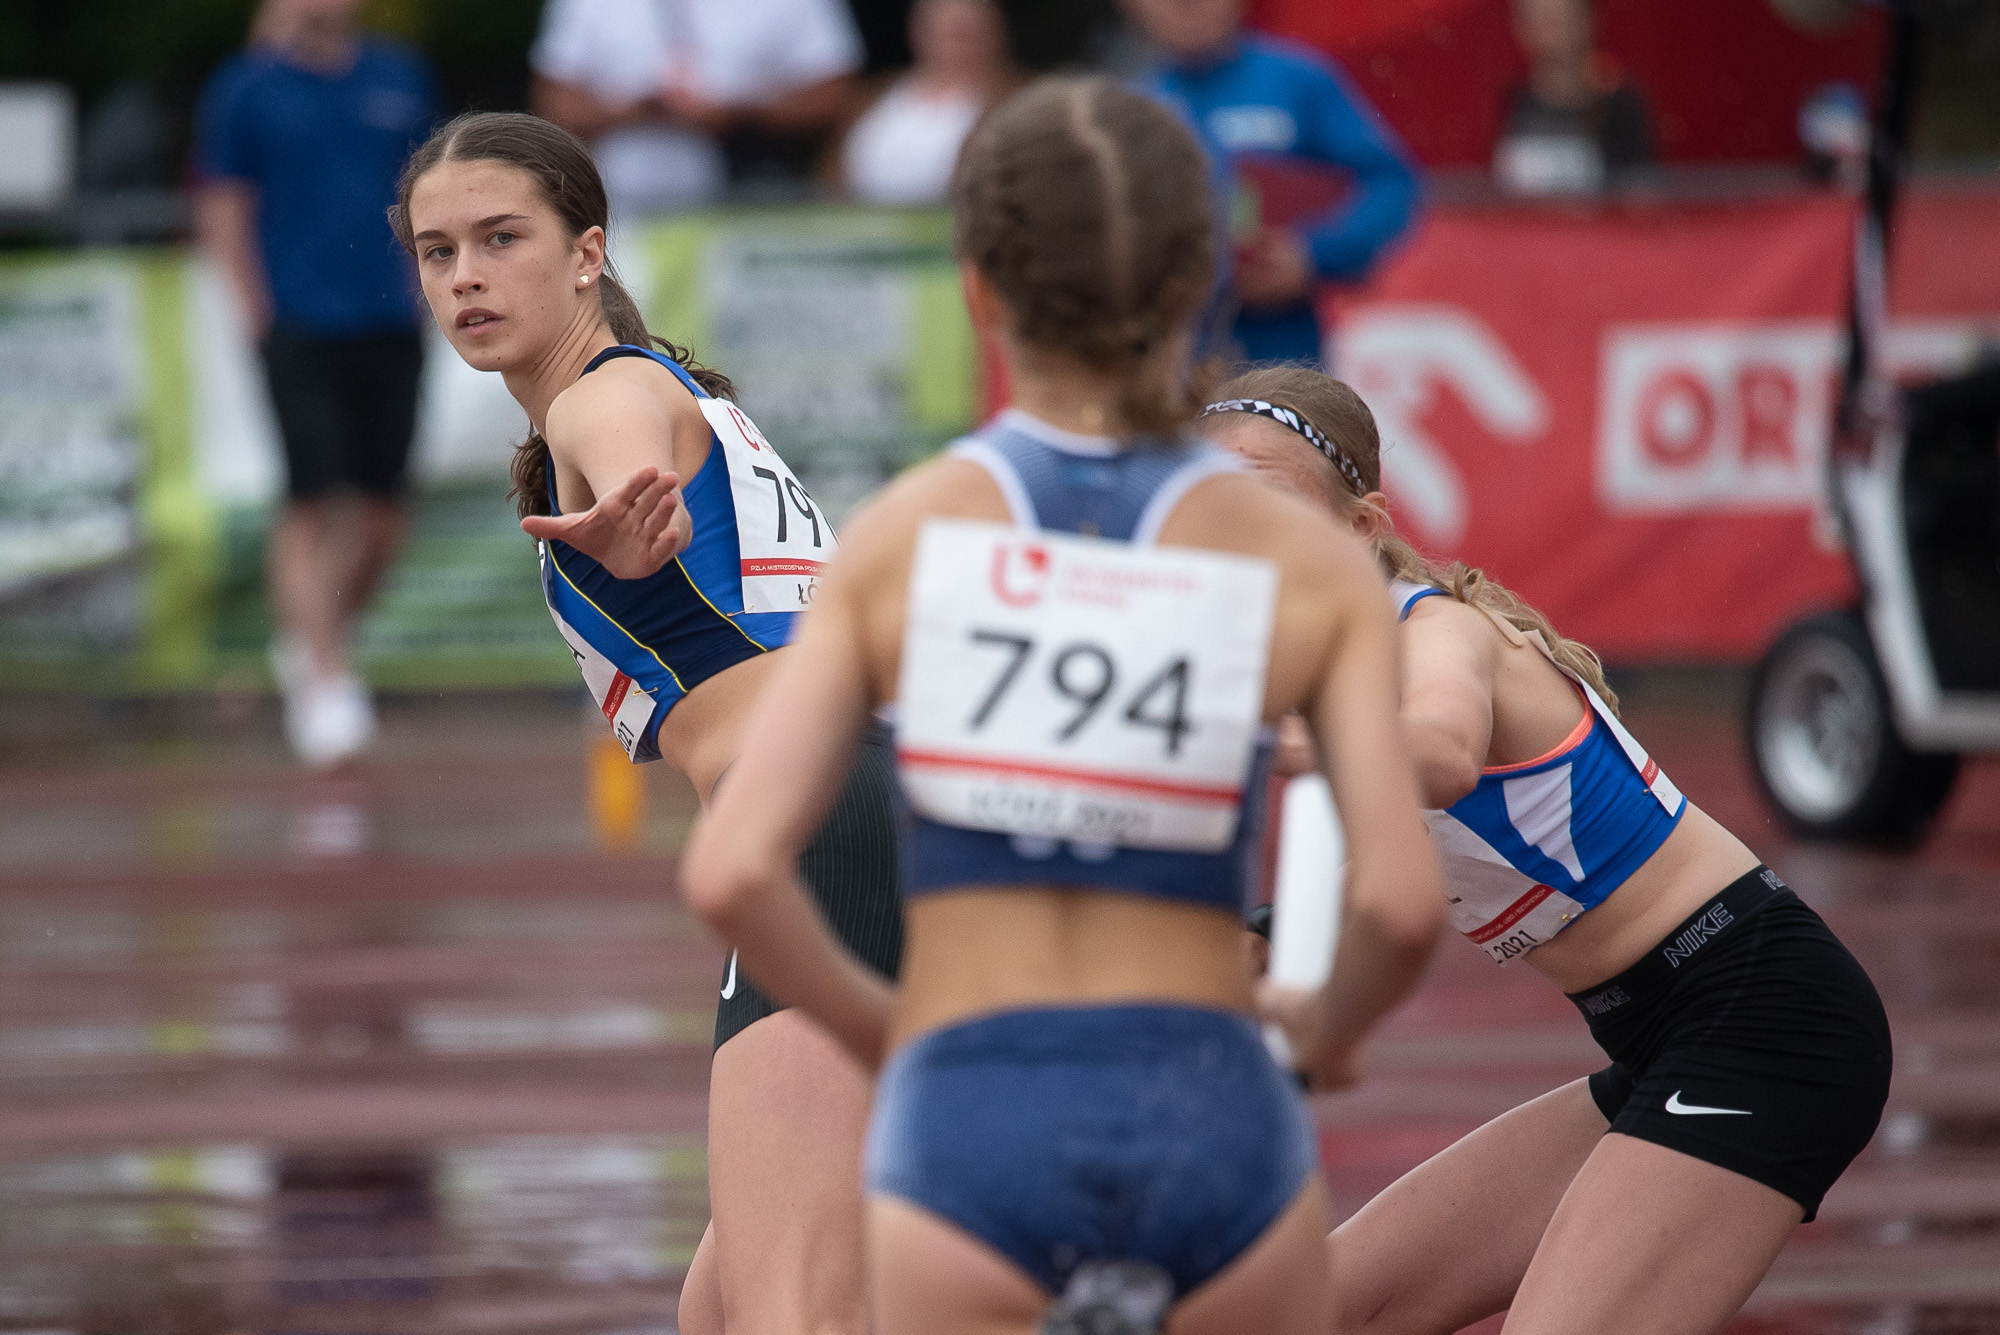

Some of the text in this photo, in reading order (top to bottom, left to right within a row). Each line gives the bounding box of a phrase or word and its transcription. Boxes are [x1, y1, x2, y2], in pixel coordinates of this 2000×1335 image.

[752, 465, 841, 548] 79
[967, 625, 1193, 757] 794
[1493, 930, 1537, 959] 2021
[1663, 903, 1734, 968] NIKE
[1582, 986, 1630, 1016] NIKE
